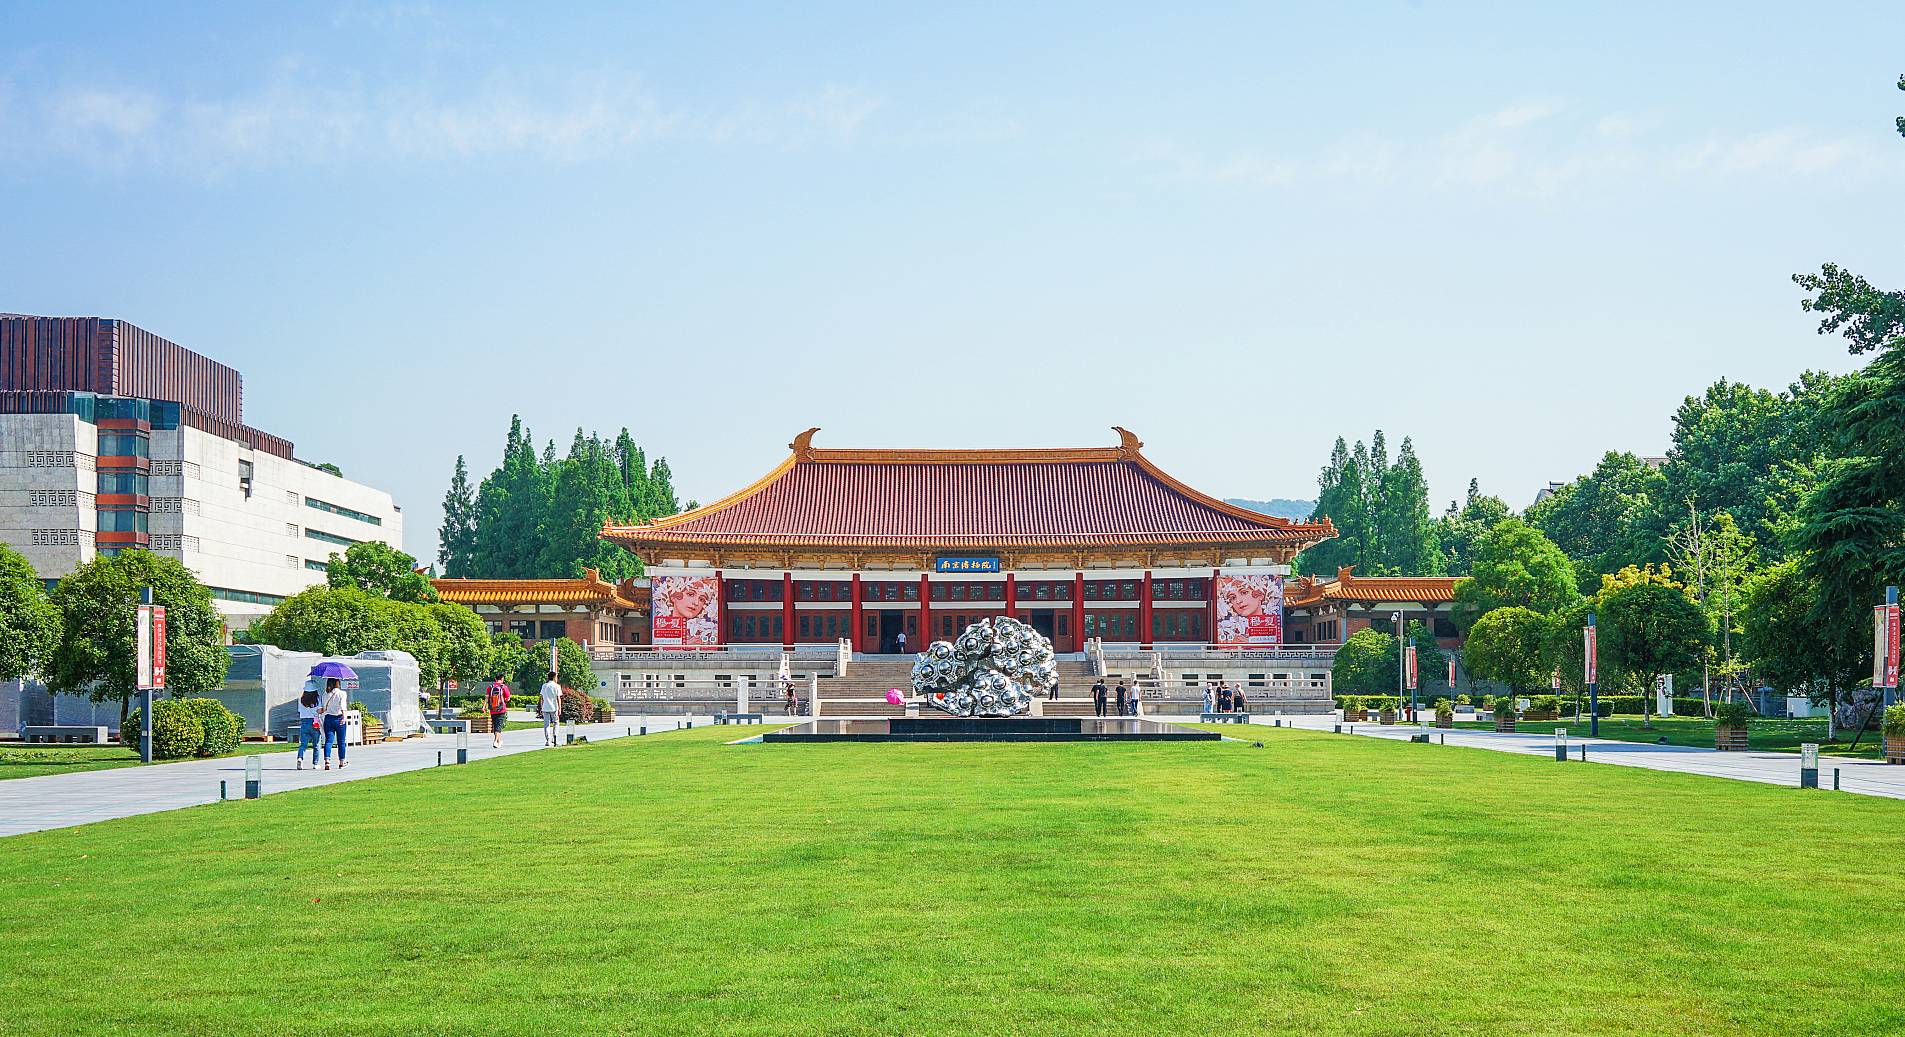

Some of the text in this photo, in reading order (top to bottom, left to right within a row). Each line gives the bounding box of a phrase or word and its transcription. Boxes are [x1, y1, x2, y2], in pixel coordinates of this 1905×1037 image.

[941, 560, 991, 569] 南京博物院
